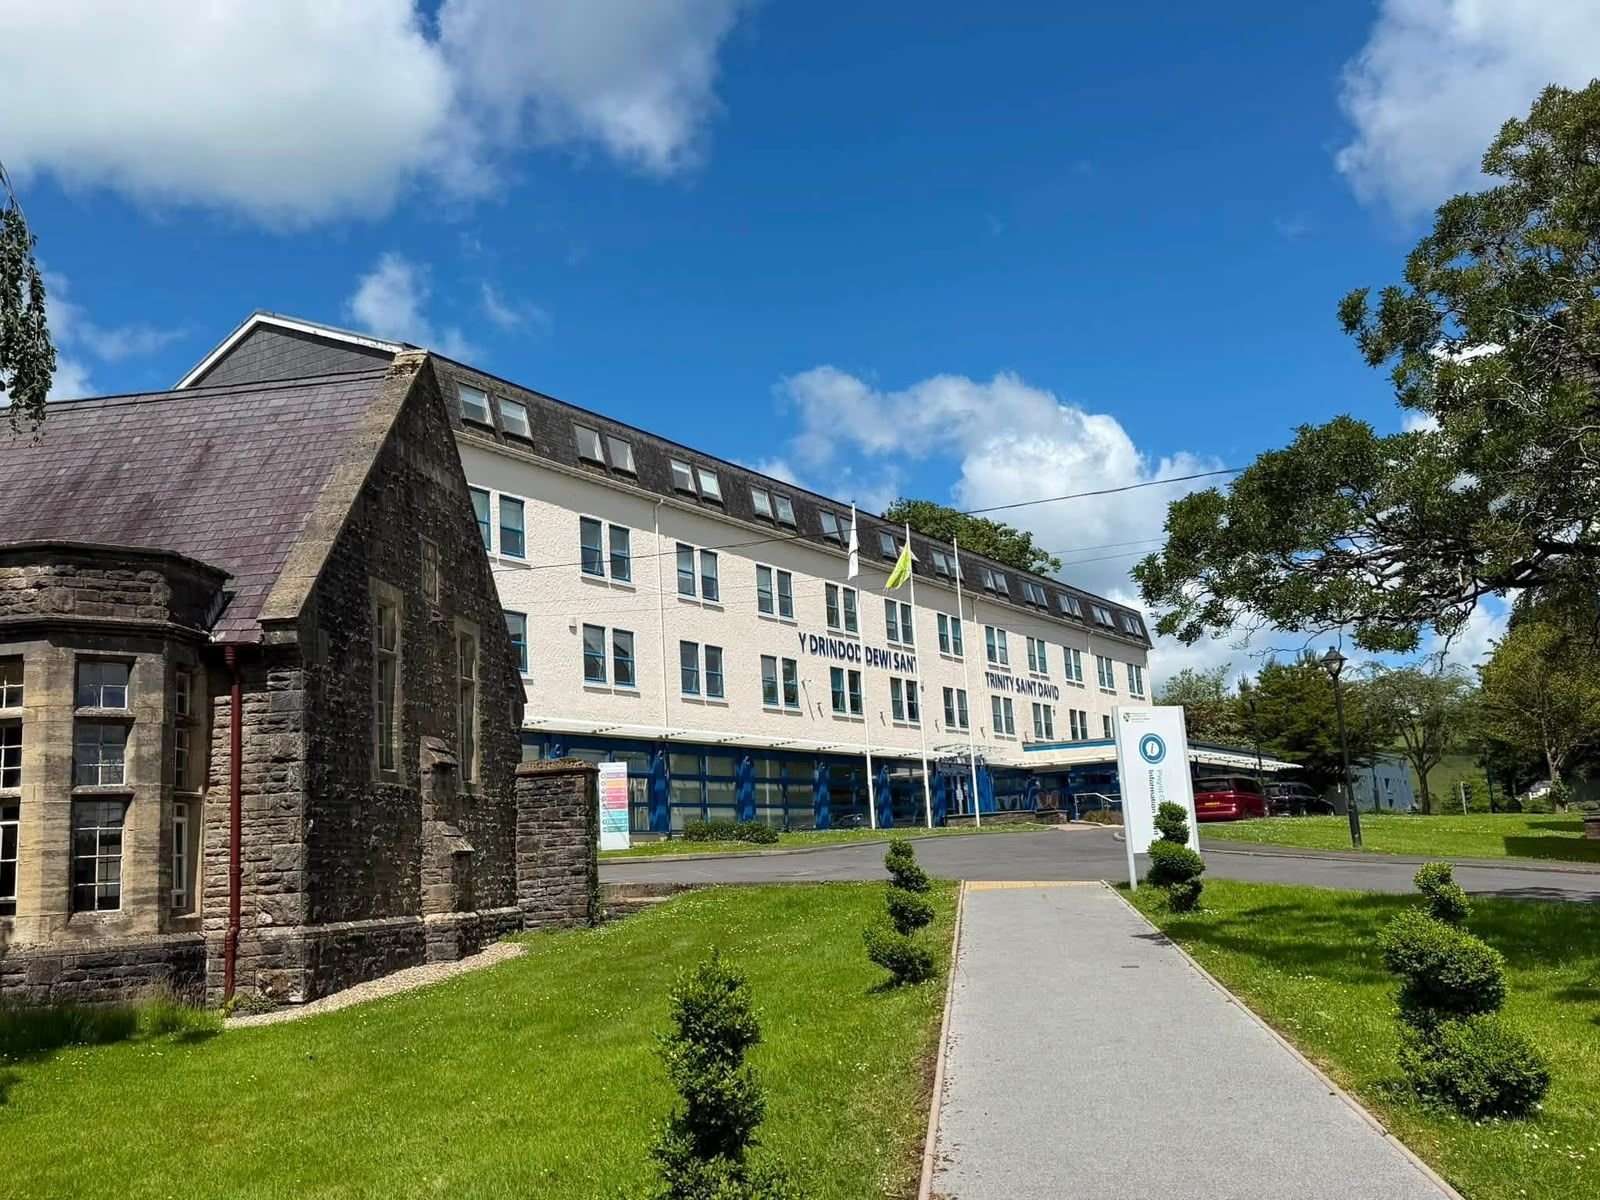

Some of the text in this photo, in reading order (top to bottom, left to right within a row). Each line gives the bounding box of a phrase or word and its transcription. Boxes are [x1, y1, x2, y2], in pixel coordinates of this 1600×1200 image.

[798, 632, 807, 654] Y
[865, 646, 892, 670] DEWI
[985, 671, 1060, 701] TRINITY SAINT DAVID
[1148, 769, 1157, 814] Information
